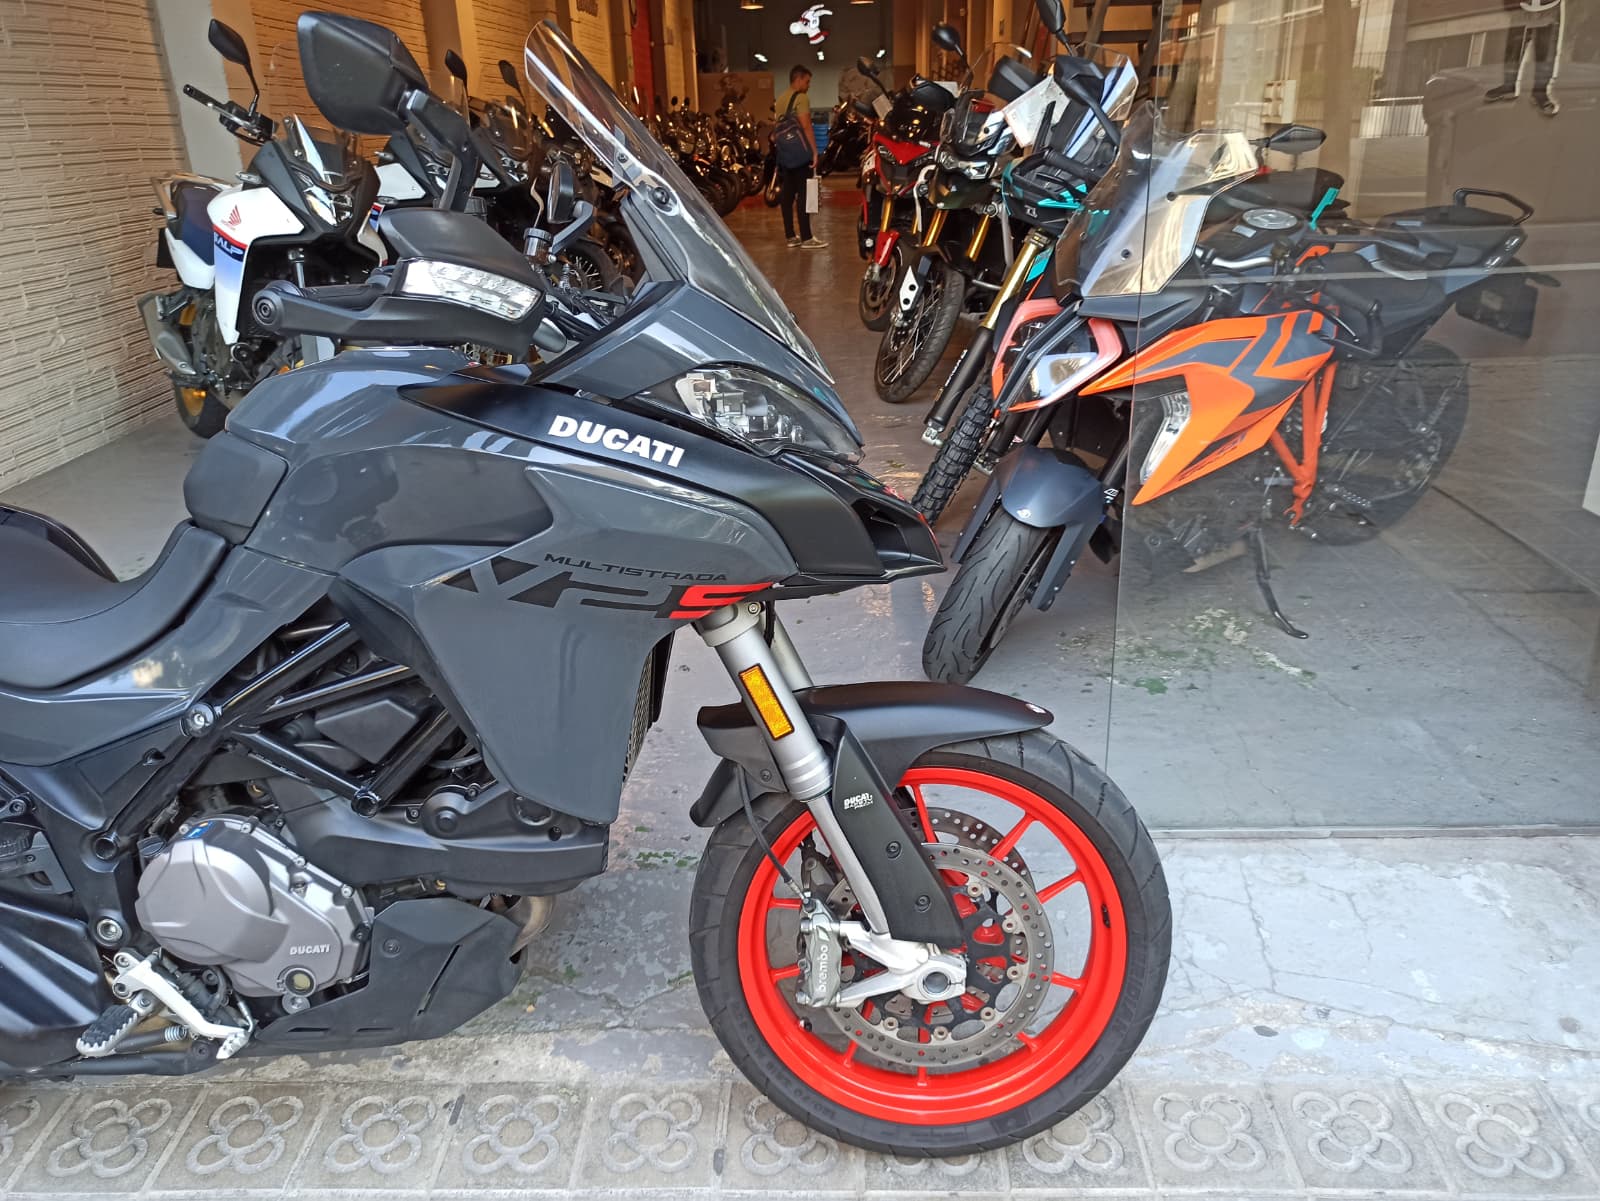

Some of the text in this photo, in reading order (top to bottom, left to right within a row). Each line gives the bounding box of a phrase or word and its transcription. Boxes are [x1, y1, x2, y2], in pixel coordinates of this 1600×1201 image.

[547, 415, 685, 468] DUCATI
[545, 553, 728, 581] MULTISTRADA
[289, 943, 331, 956] DUCATI
[818, 943, 830, 993] brembo
